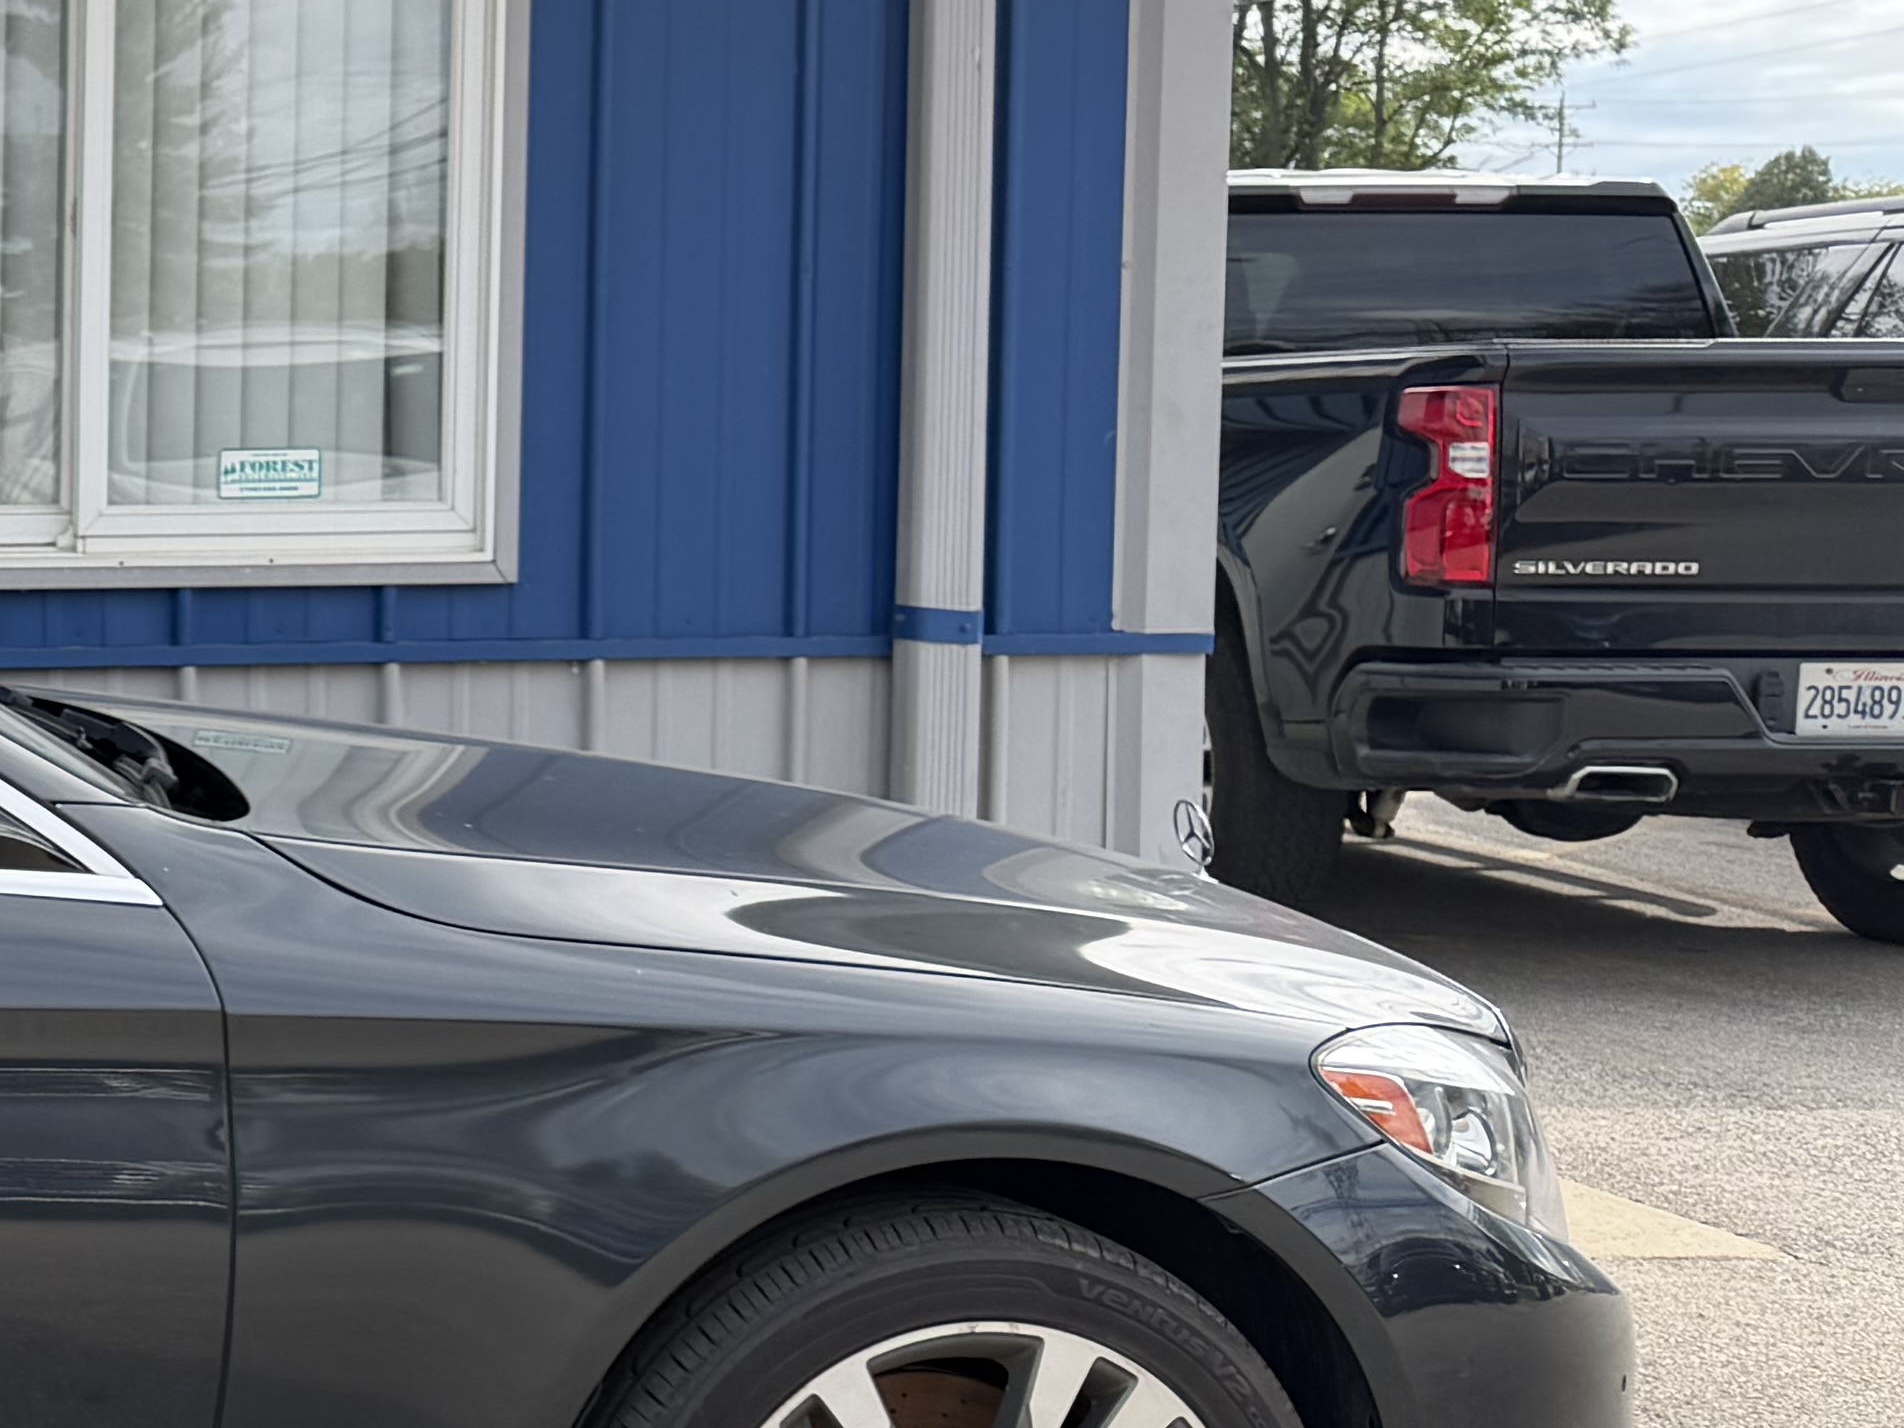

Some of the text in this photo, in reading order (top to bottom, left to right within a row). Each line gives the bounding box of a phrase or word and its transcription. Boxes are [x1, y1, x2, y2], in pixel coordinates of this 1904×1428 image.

[239, 459, 318, 473] FOREST
[1512, 560, 1701, 576] SILVERADO
[1803, 684, 1904, 721] 285489
